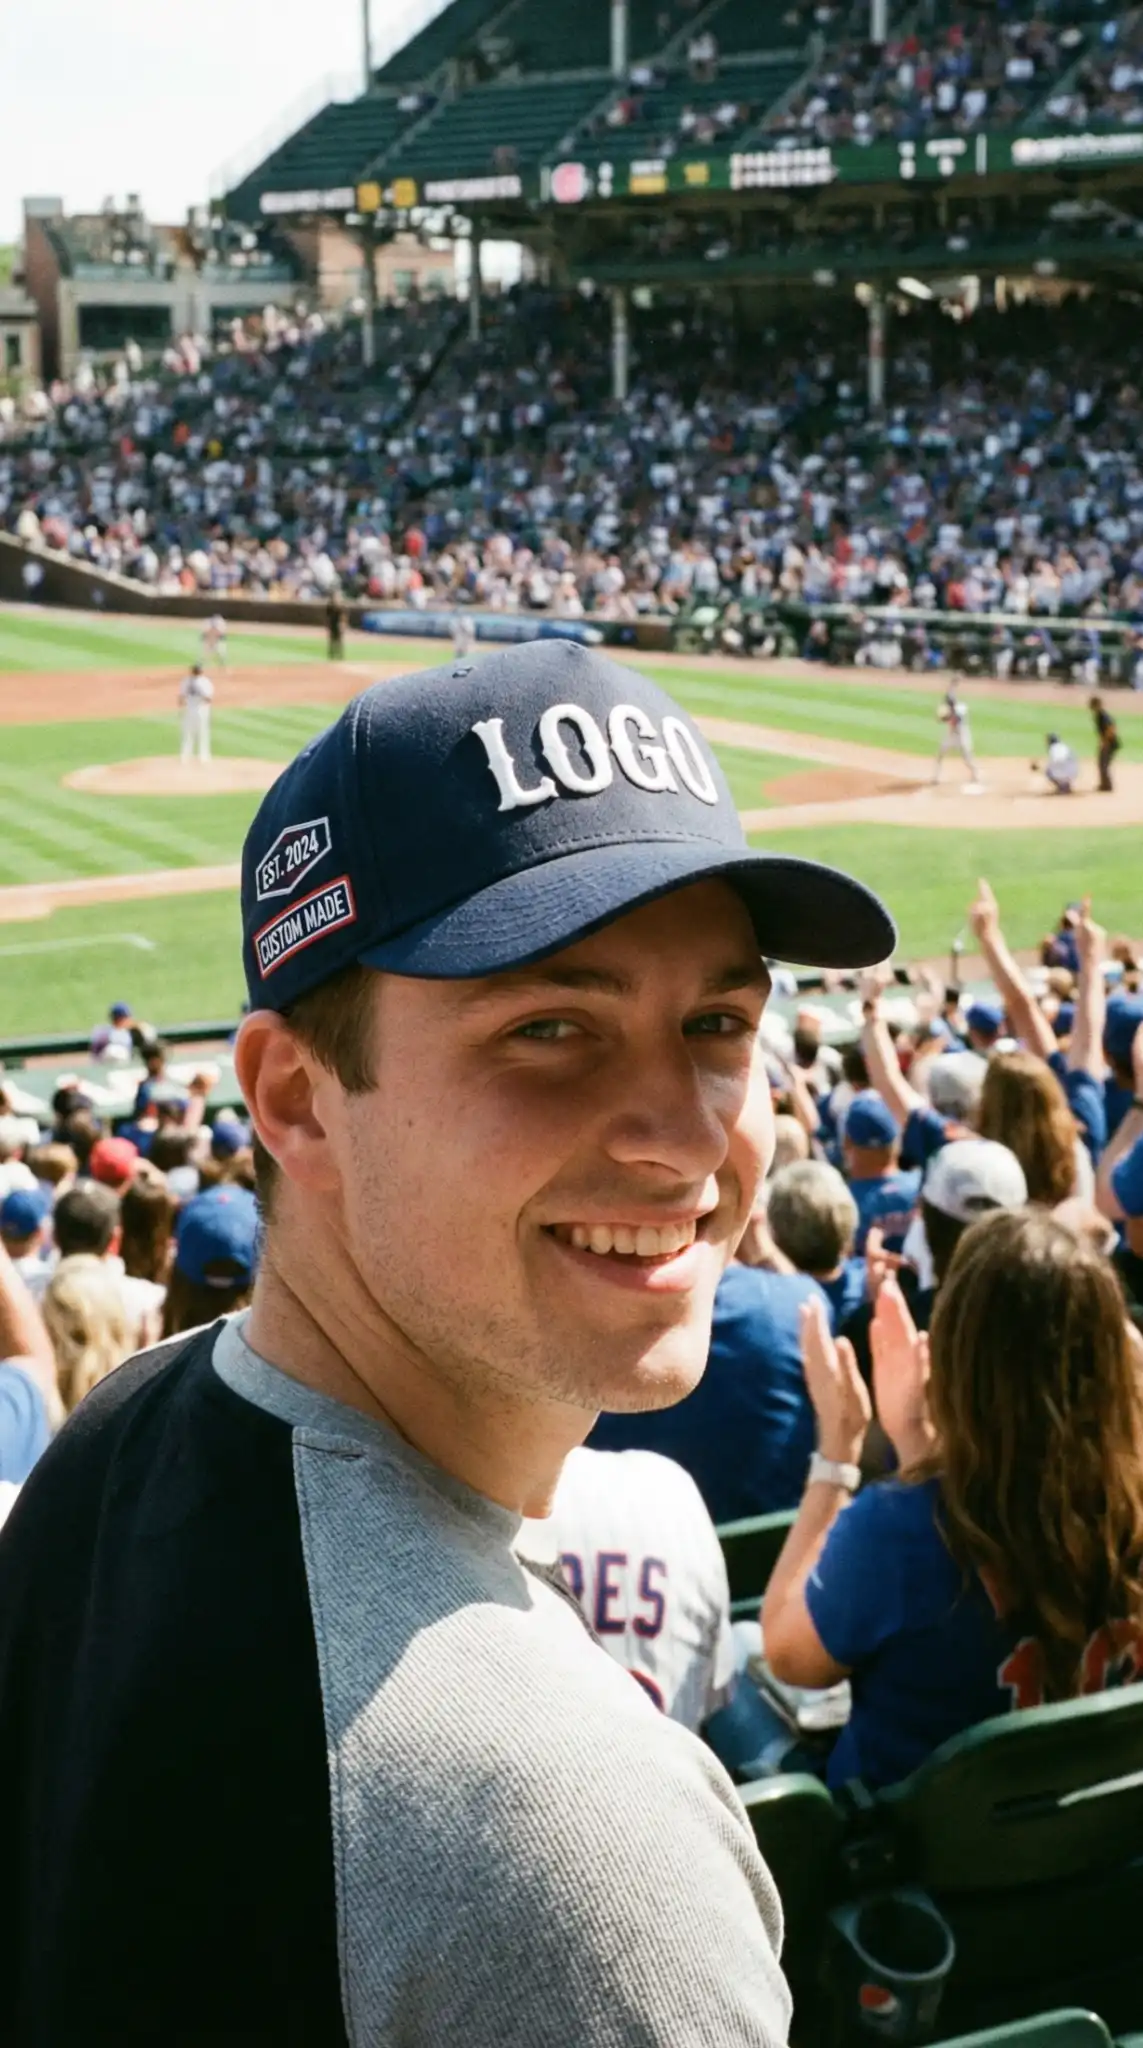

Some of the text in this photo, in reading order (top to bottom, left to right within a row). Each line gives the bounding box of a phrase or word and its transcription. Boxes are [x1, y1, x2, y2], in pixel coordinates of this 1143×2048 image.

[472, 703, 719, 812] LOGO
[261, 828, 319, 891] EST. 2024
[260, 890, 346, 966] CUSTOM MADE
